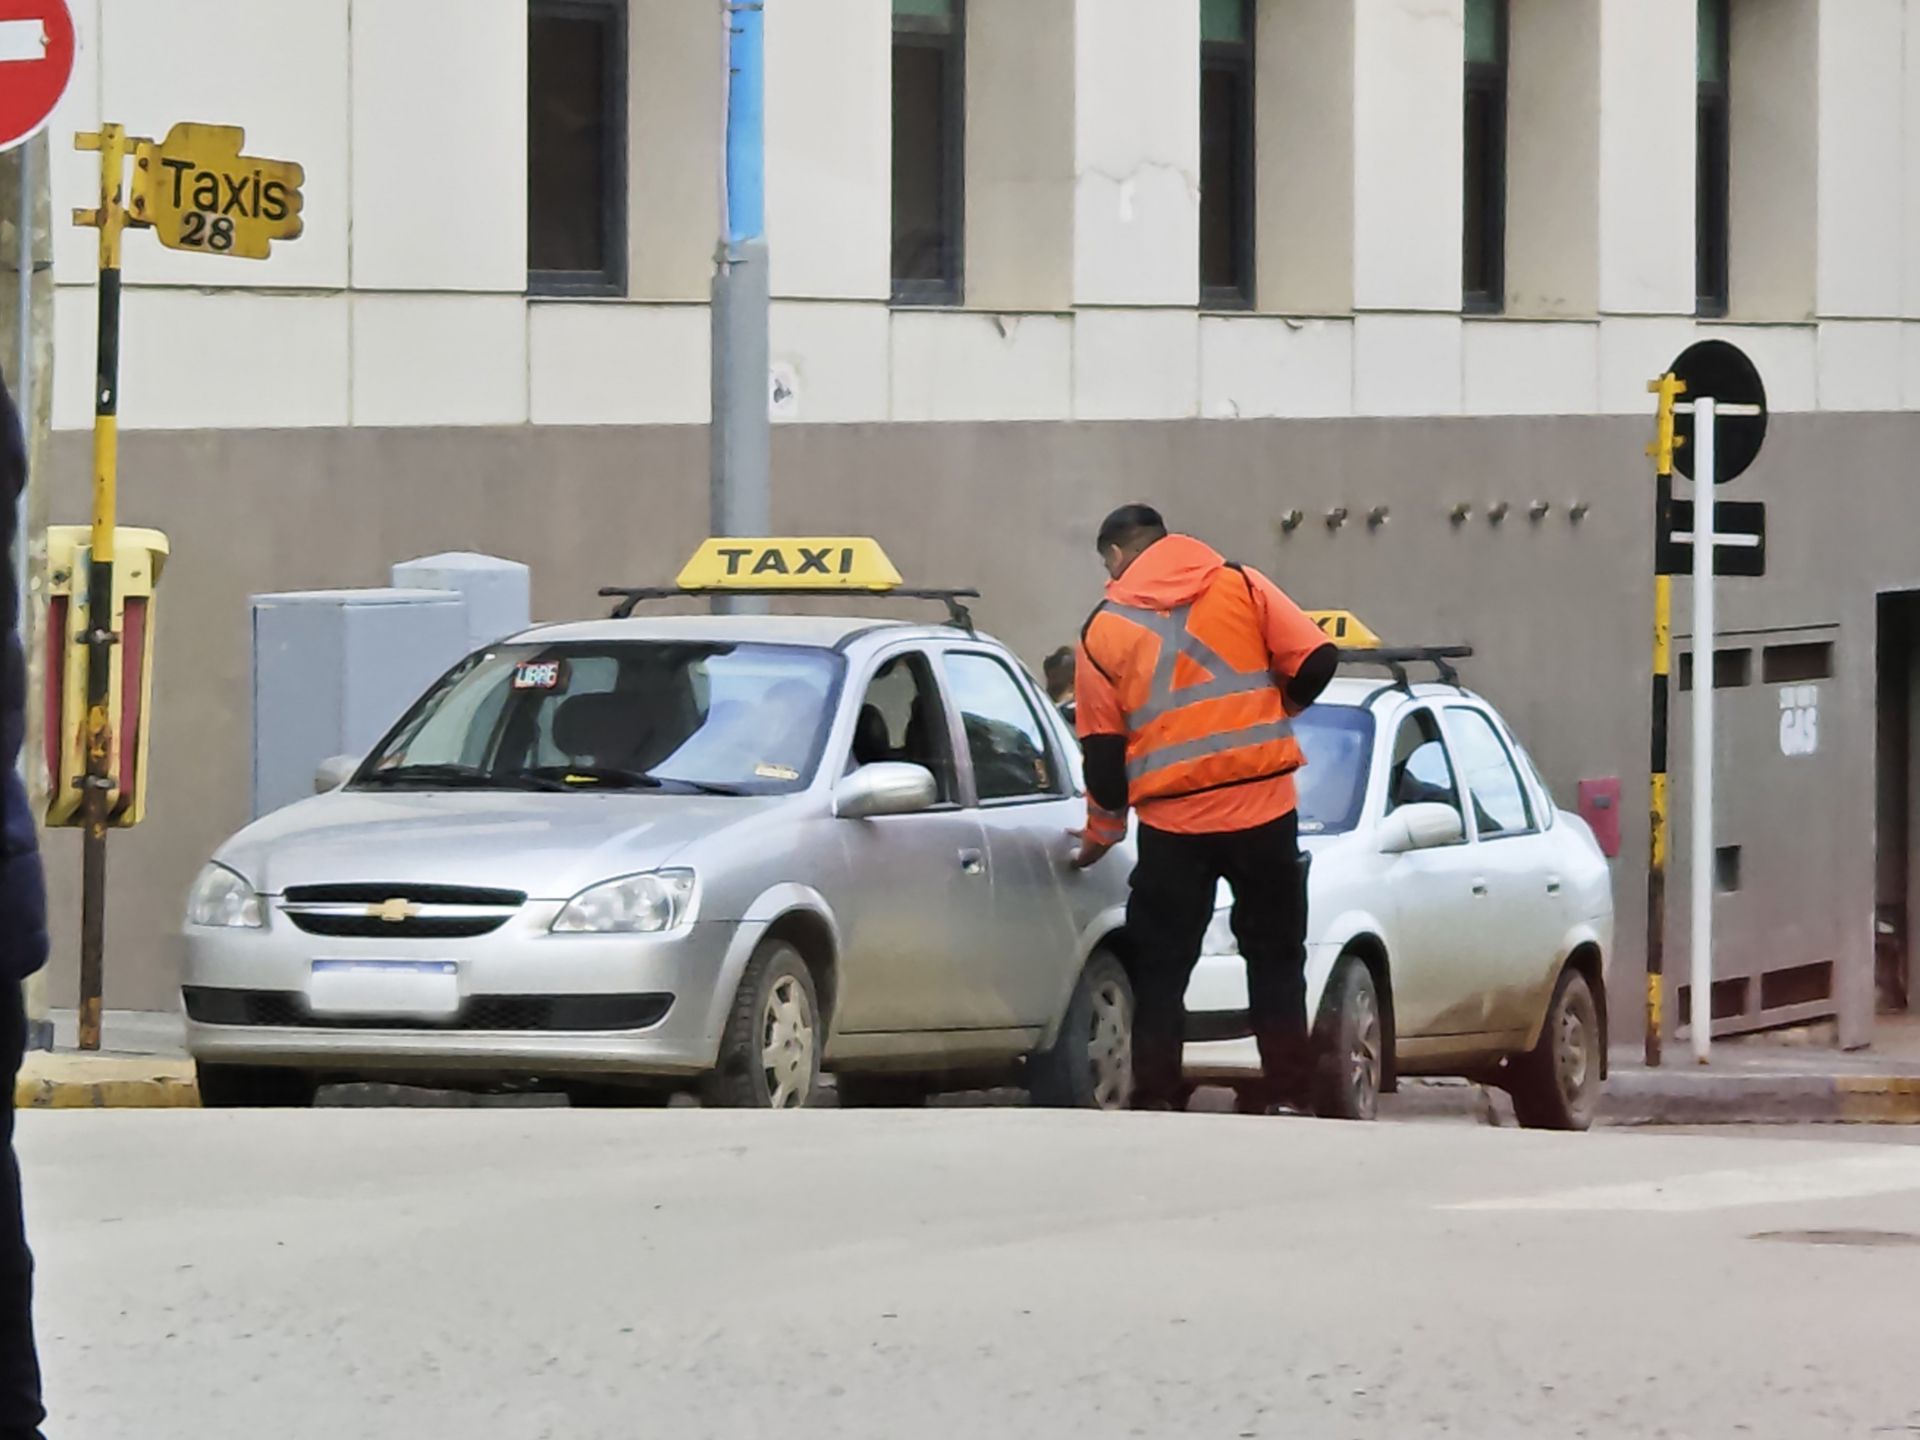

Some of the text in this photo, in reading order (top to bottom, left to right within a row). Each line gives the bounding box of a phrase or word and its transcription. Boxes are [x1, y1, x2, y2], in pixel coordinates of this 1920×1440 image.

[161, 158, 288, 220] Taxis
[180, 211, 234, 250] 28
[717, 548, 854, 575] TAXI
